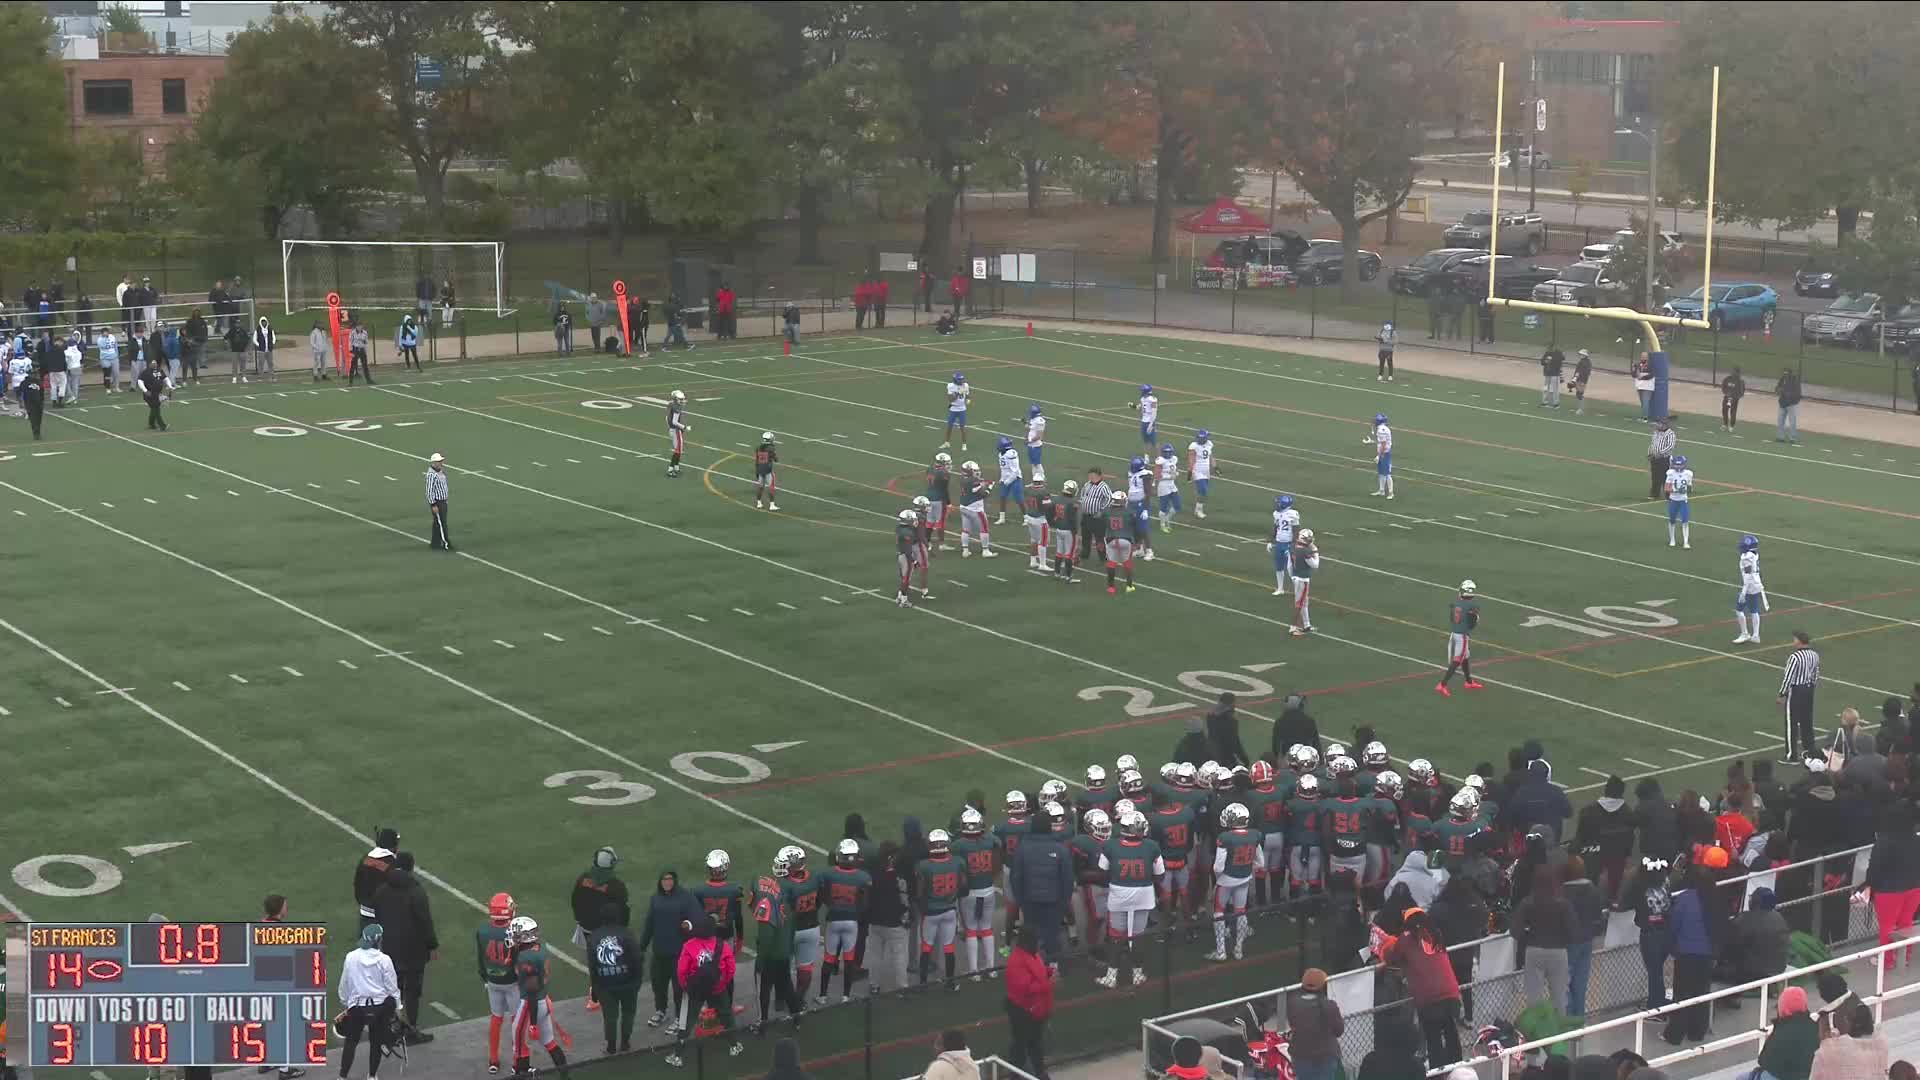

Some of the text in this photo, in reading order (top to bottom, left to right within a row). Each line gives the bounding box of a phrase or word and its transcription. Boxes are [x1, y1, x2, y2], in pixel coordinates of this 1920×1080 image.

[1520, 606, 1678, 637] 10
[1077, 670, 1274, 717] 20
[544, 751, 771, 806] 30
[1336, 812, 1361, 833] 54
[1119, 858, 1145, 880] 70
